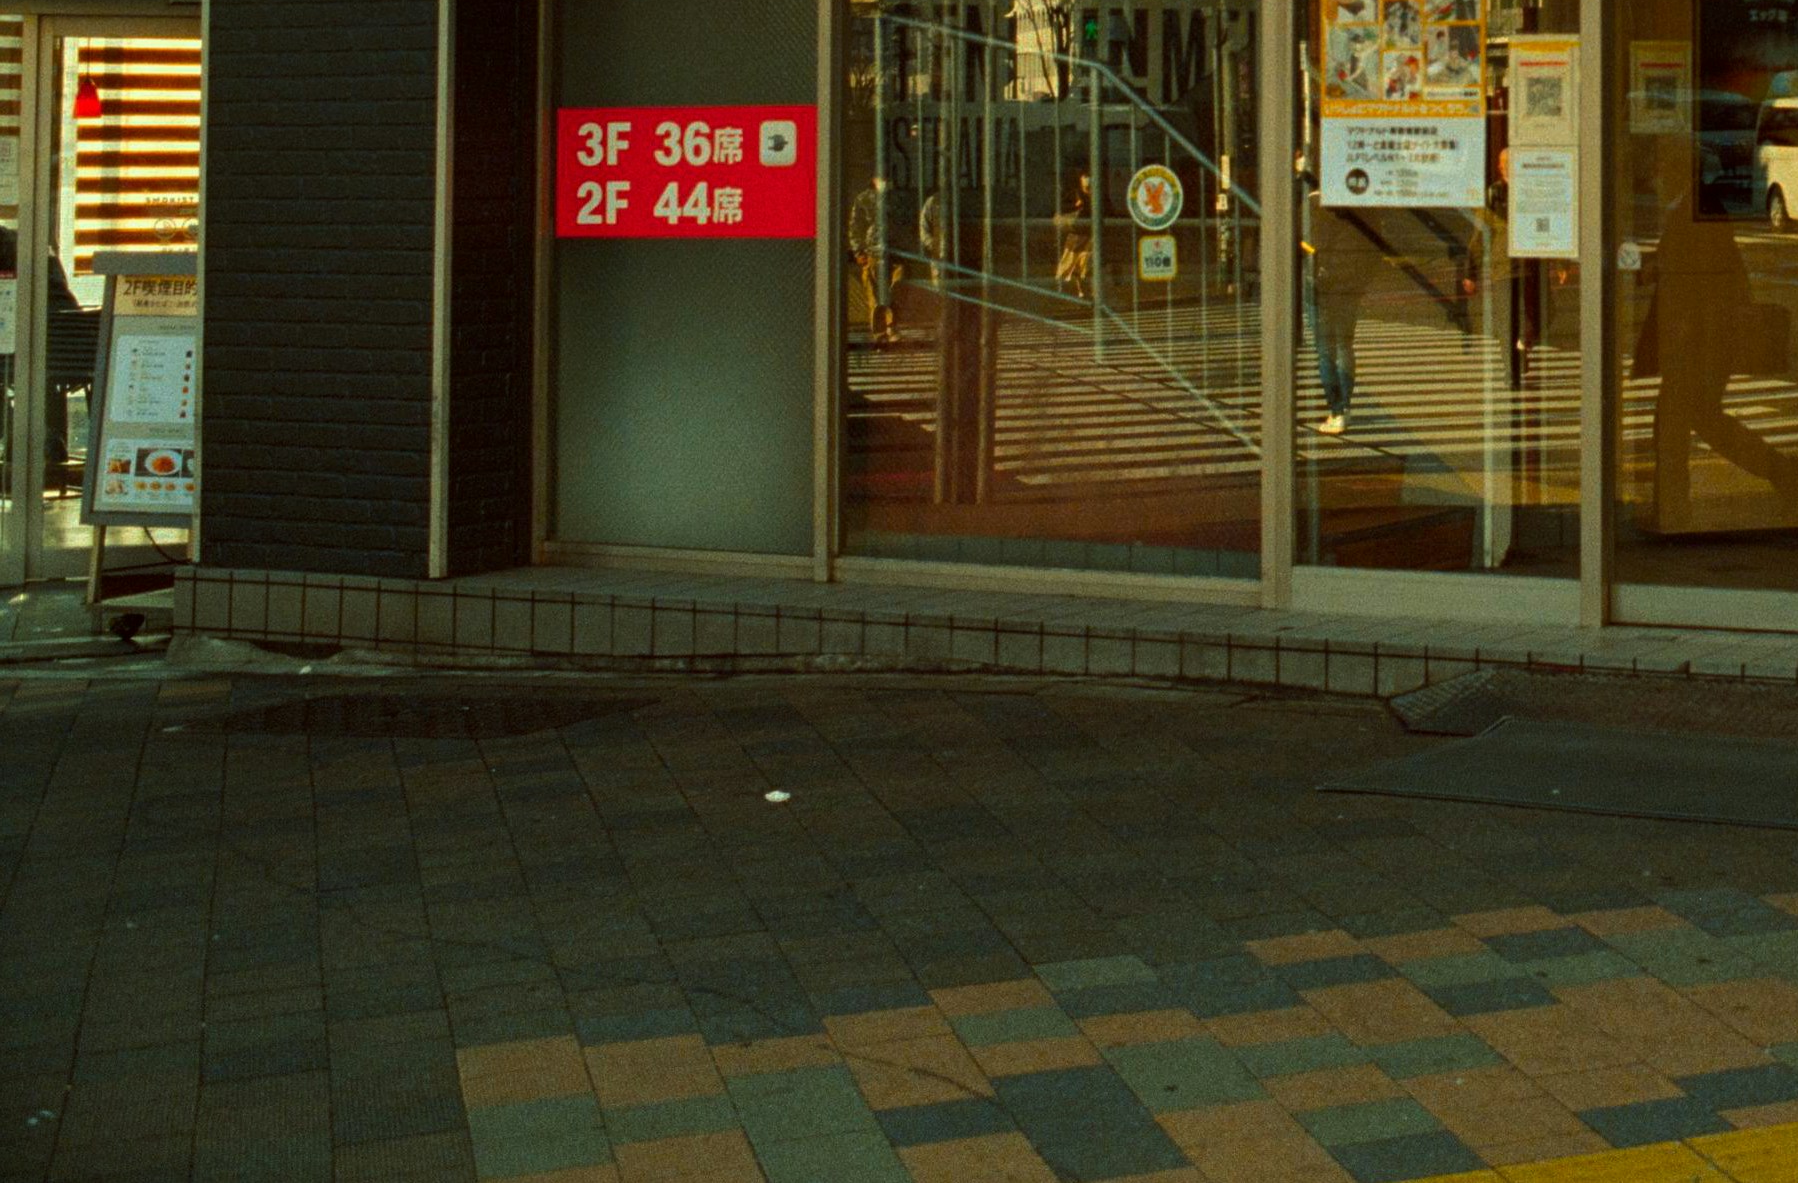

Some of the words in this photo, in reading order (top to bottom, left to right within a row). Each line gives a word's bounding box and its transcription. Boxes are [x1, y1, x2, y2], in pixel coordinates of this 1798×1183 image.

[577, 121, 631, 166] 3F
[653, 121, 743, 166] 36席
[576, 180, 631, 225] 2F
[653, 181, 743, 225] 44席
